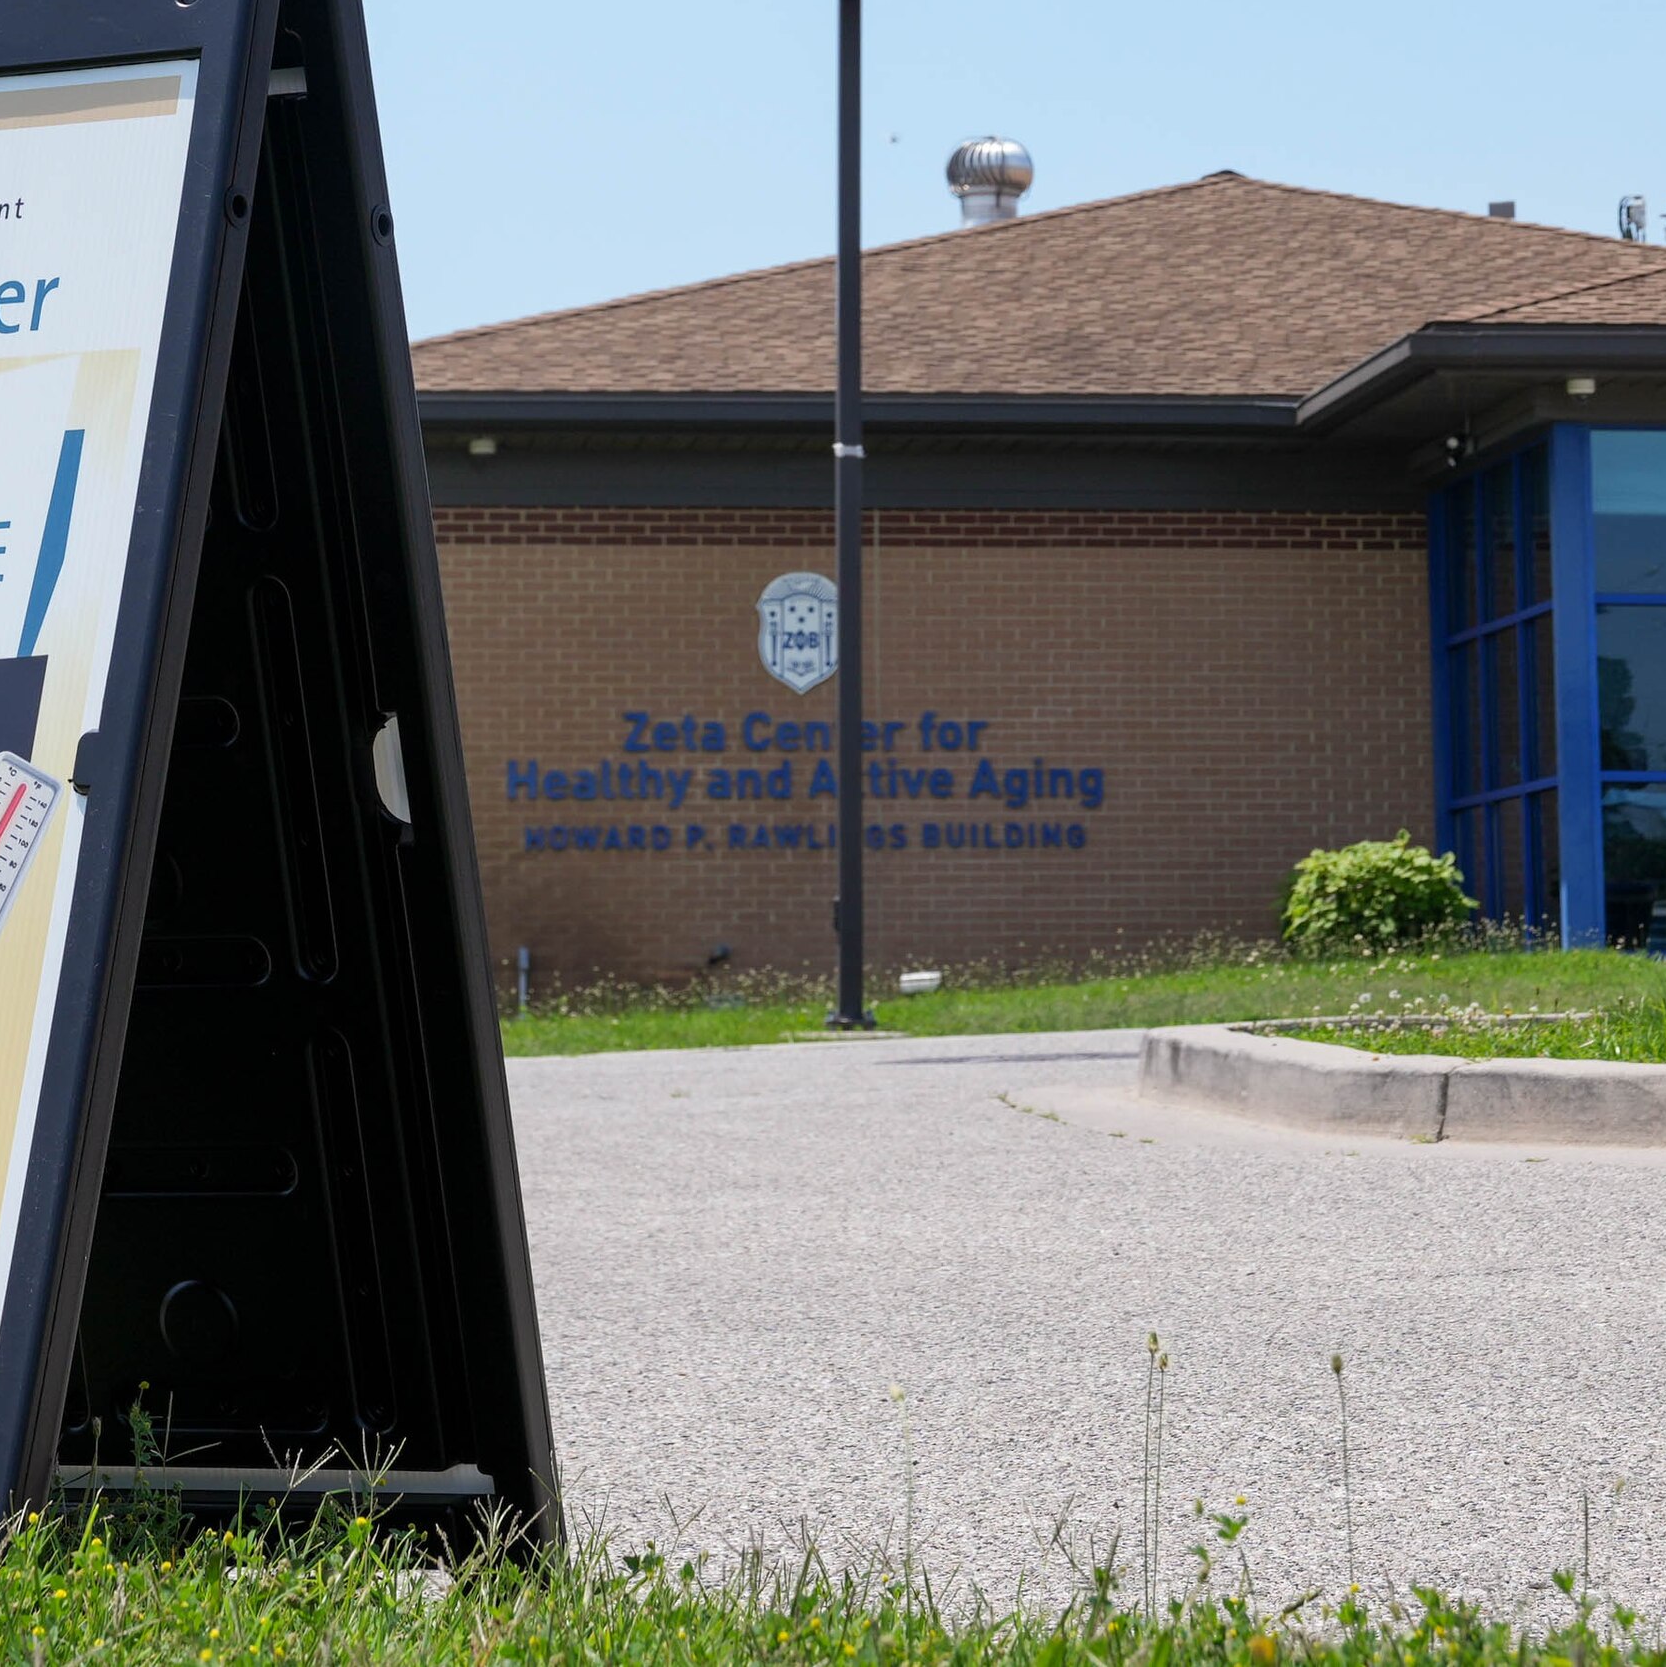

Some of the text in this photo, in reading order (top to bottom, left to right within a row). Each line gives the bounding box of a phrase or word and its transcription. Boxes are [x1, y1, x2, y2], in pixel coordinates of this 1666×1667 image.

[623, 710, 988, 753] Zeta Cener for
[506, 757, 1105, 810] Healthy and Ative Aging
[524, 822, 1087, 851] HOWARD P. RAWLIGS BUILDING
